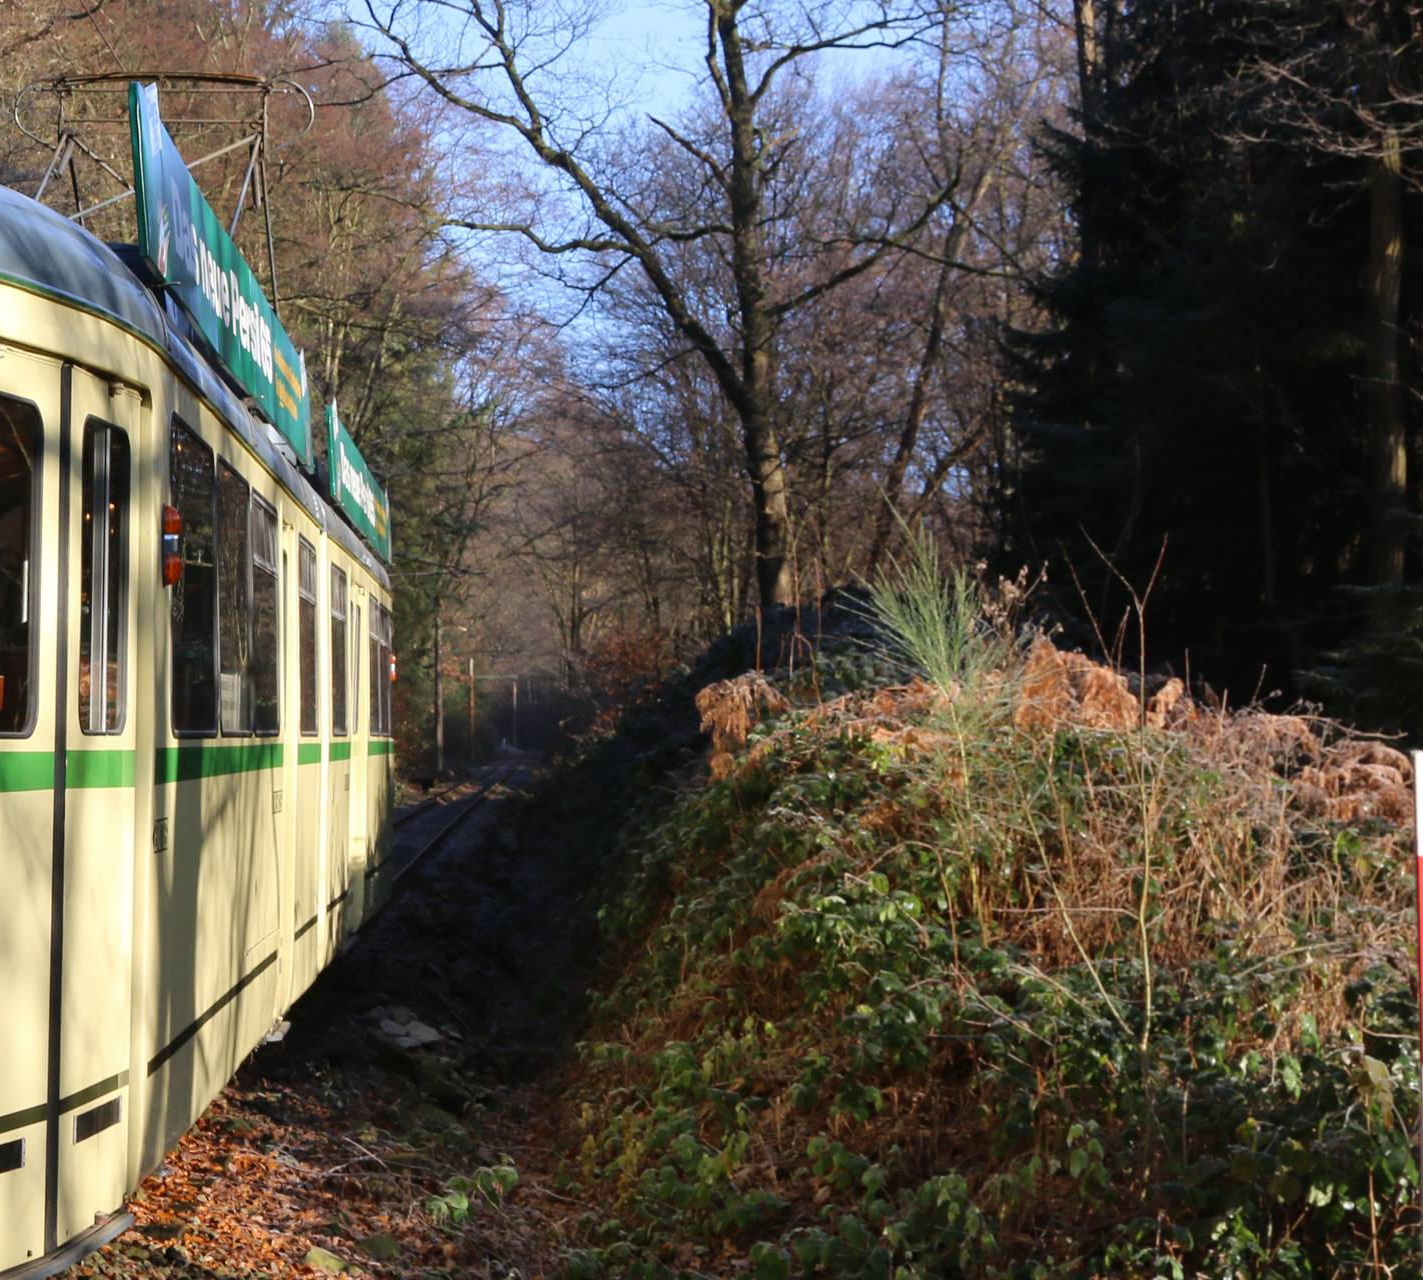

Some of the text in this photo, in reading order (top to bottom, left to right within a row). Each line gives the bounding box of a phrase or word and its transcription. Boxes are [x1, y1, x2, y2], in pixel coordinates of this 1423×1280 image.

[170, 175, 200, 286] Das
[199, 238, 230, 328] neue
[230, 269, 262, 369] Persil
